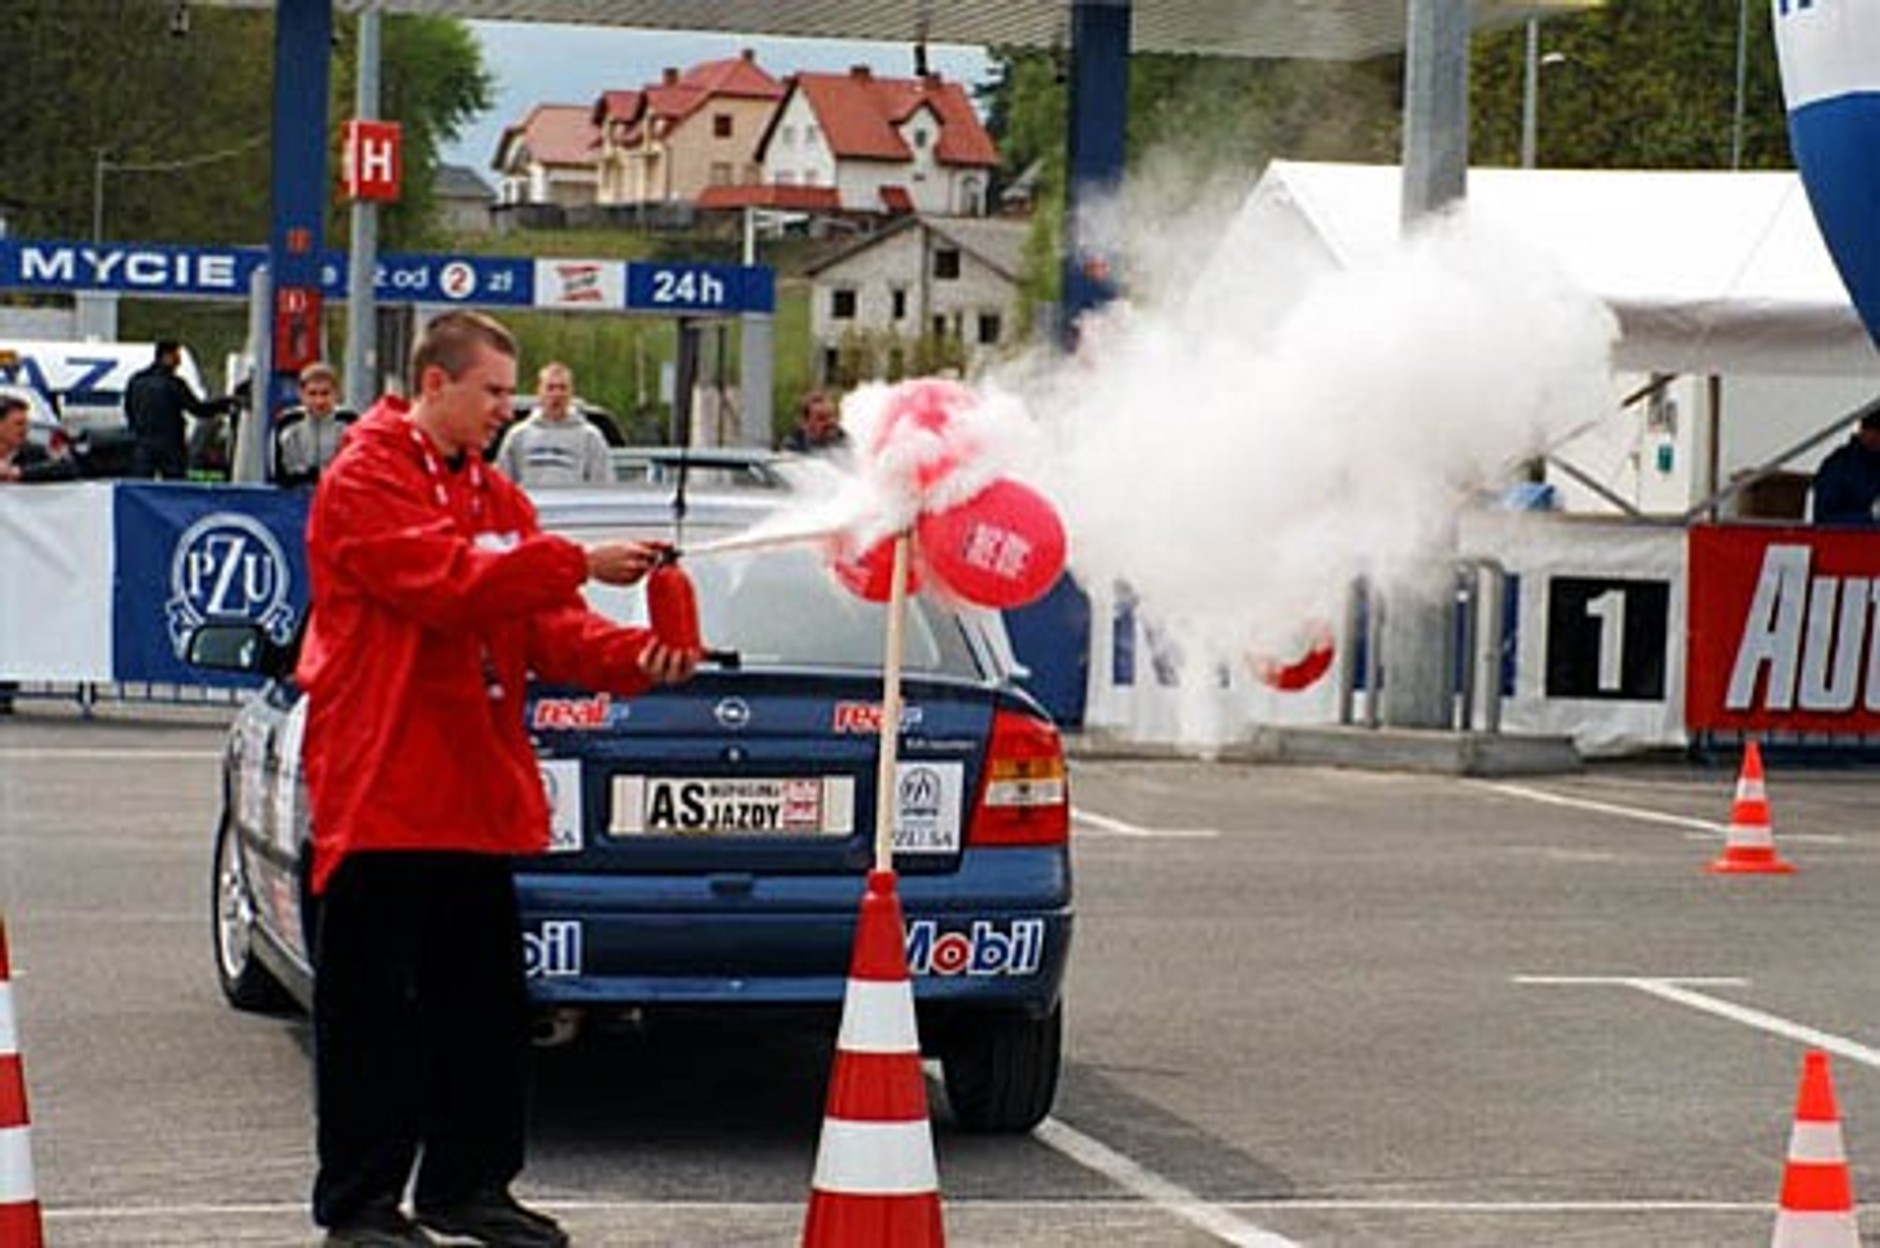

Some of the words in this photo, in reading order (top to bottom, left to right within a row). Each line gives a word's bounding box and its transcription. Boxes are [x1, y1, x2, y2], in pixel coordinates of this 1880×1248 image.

[362, 138, 393, 183] H
[21, 248, 236, 287] MYCIE
[188, 533, 272, 615] PZU
[1585, 589, 1627, 691] 1
[650, 784, 705, 827] AS
[710, 803, 781, 829] JAZDY
